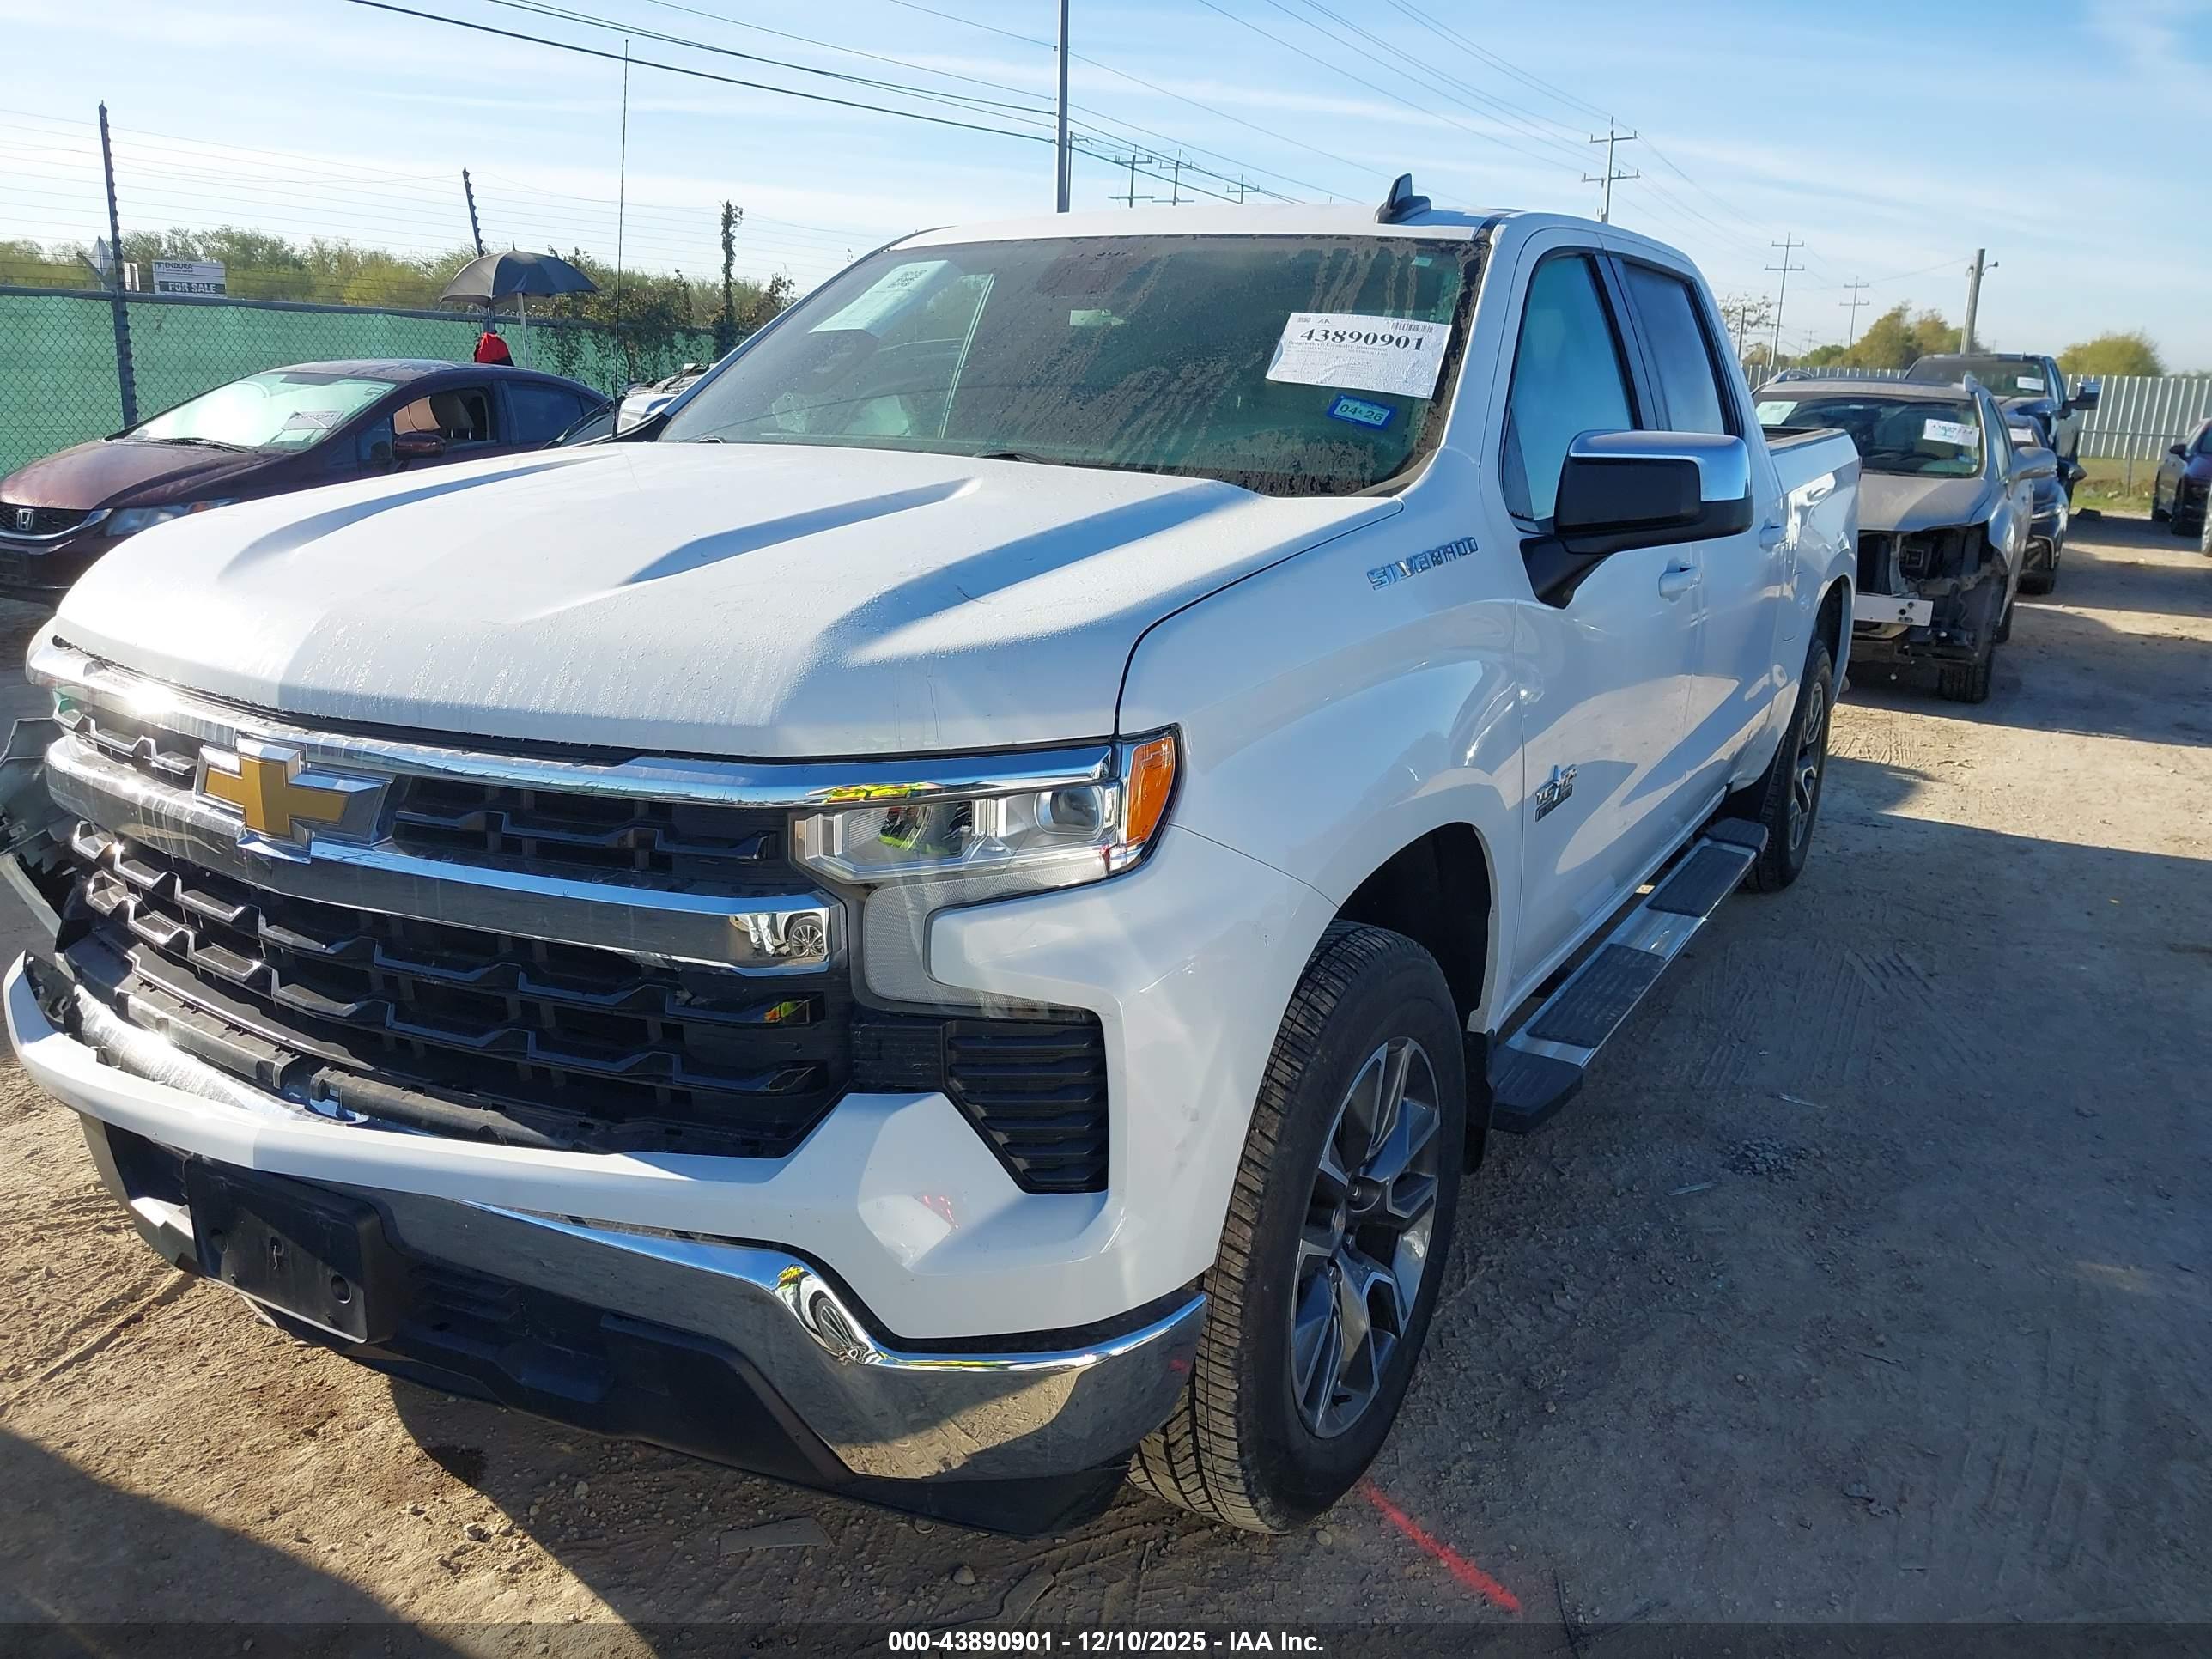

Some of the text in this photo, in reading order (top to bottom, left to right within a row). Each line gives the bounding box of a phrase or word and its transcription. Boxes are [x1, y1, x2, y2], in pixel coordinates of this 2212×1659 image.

[167, 282, 216, 293] FOR SALE
[1299, 328, 1425, 351] 43890901
[1366, 535, 1479, 591] SILVERADO
